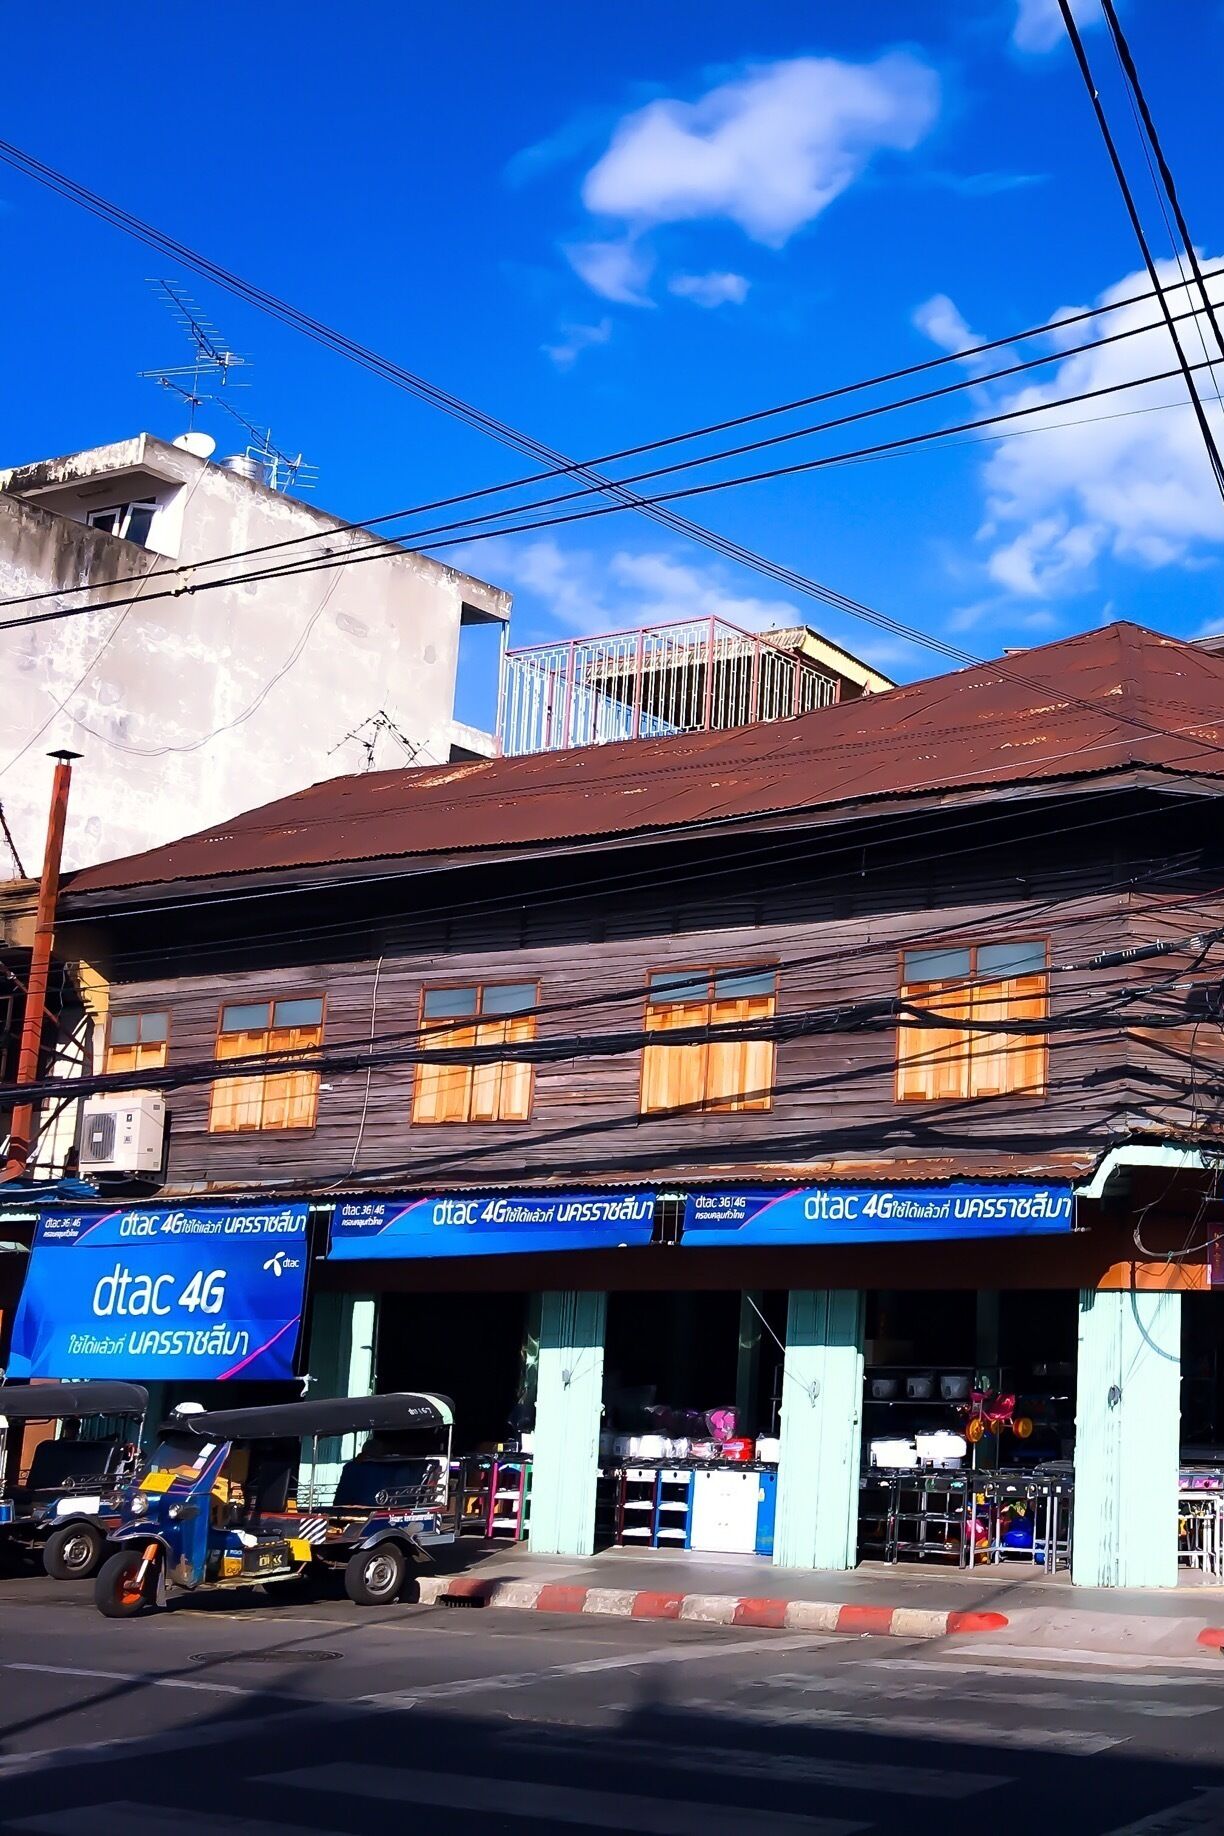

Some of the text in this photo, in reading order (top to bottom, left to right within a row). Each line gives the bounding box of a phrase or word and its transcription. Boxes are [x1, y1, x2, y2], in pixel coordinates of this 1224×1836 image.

[343, 1204, 360, 1215] dtac
[434, 1200, 478, 1225] dtac
[480, 1199, 507, 1222] 4G
[557, 1196, 653, 1221] นครราชสีมา
[696, 1196, 717, 1208] dtac
[805, 1191, 858, 1219] dtac
[862, 1194, 894, 1218] 4G
[955, 1192, 1071, 1218] นครราชสีมา
[119, 1212, 160, 1236] dtac
[161, 1213, 182, 1233] 4G
[225, 1210, 306, 1233] นครราชสีมา
[283, 1257, 300, 1268] dtac
[93, 1264, 226, 1315] dtac 4G
[67, 1323, 248, 1356] ใช้ได้แล้วที่ นครราชสีมา
